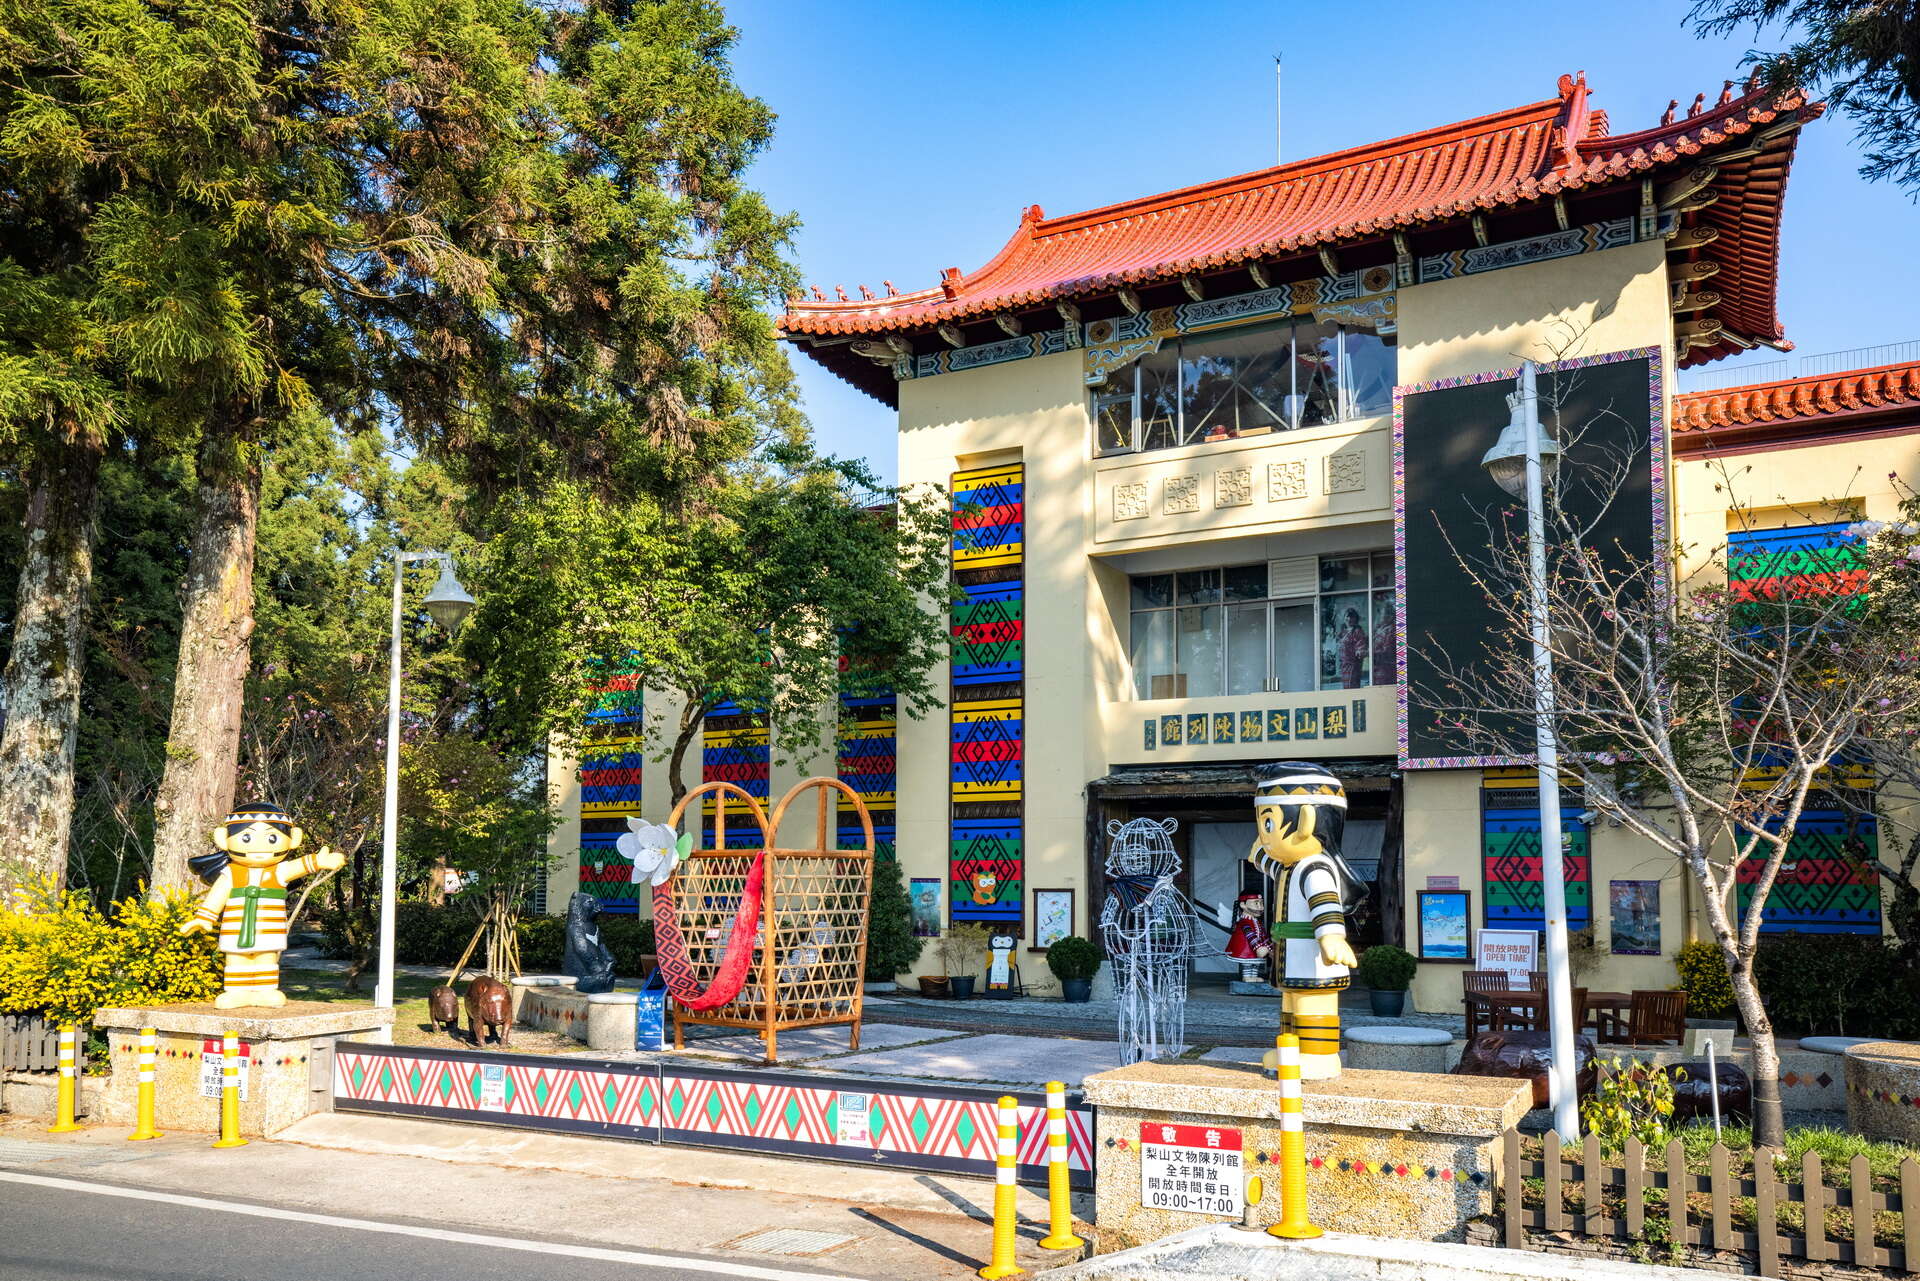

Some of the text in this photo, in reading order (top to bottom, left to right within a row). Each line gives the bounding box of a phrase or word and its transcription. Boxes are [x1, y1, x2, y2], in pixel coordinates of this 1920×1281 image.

[1486, 953, 1527, 962] OPEN TIME
[1147, 1147, 1239, 1167] 梨山文物陳列館
[1166, 1164, 1218, 1180] 全年開放
[1152, 1192, 1233, 1212] 09:00~17:00
